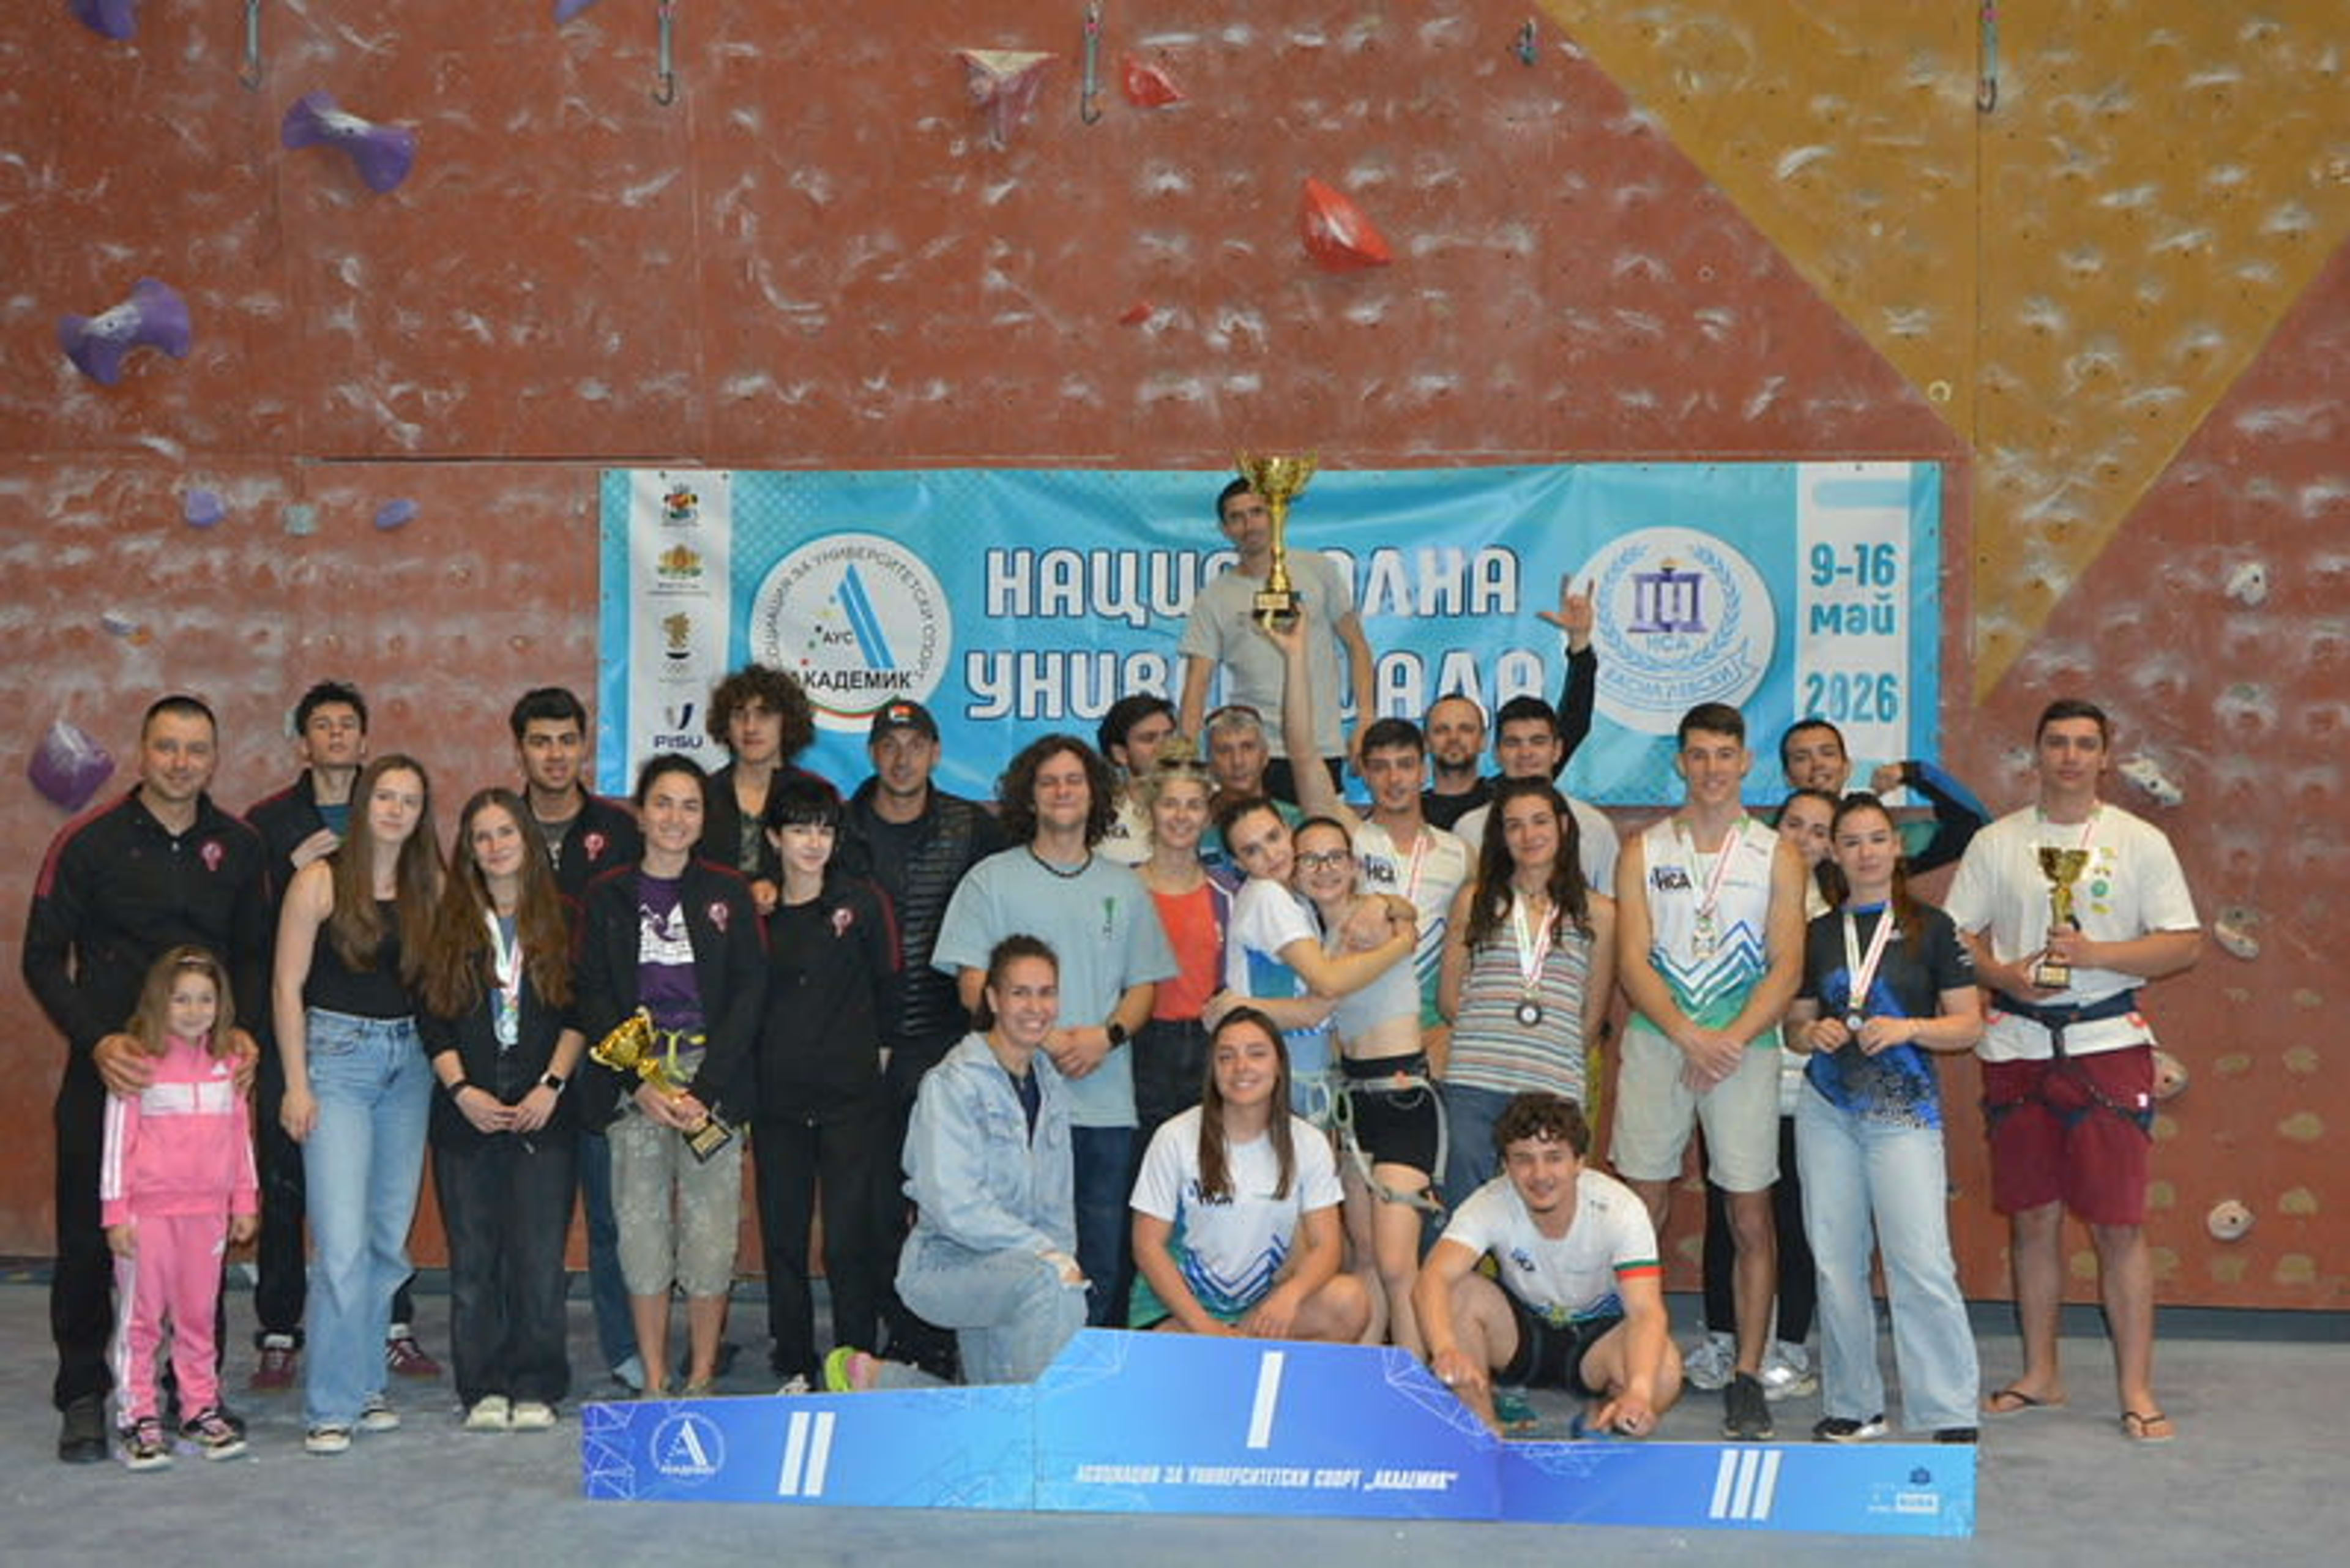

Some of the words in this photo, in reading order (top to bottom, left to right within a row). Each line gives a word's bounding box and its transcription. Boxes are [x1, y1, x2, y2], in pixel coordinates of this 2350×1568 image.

[1810, 542, 1895, 586] 9-16
[1810, 591, 1895, 635] май
[823, 630, 854, 644] АУС
[1805, 673, 1897, 722] 2026
